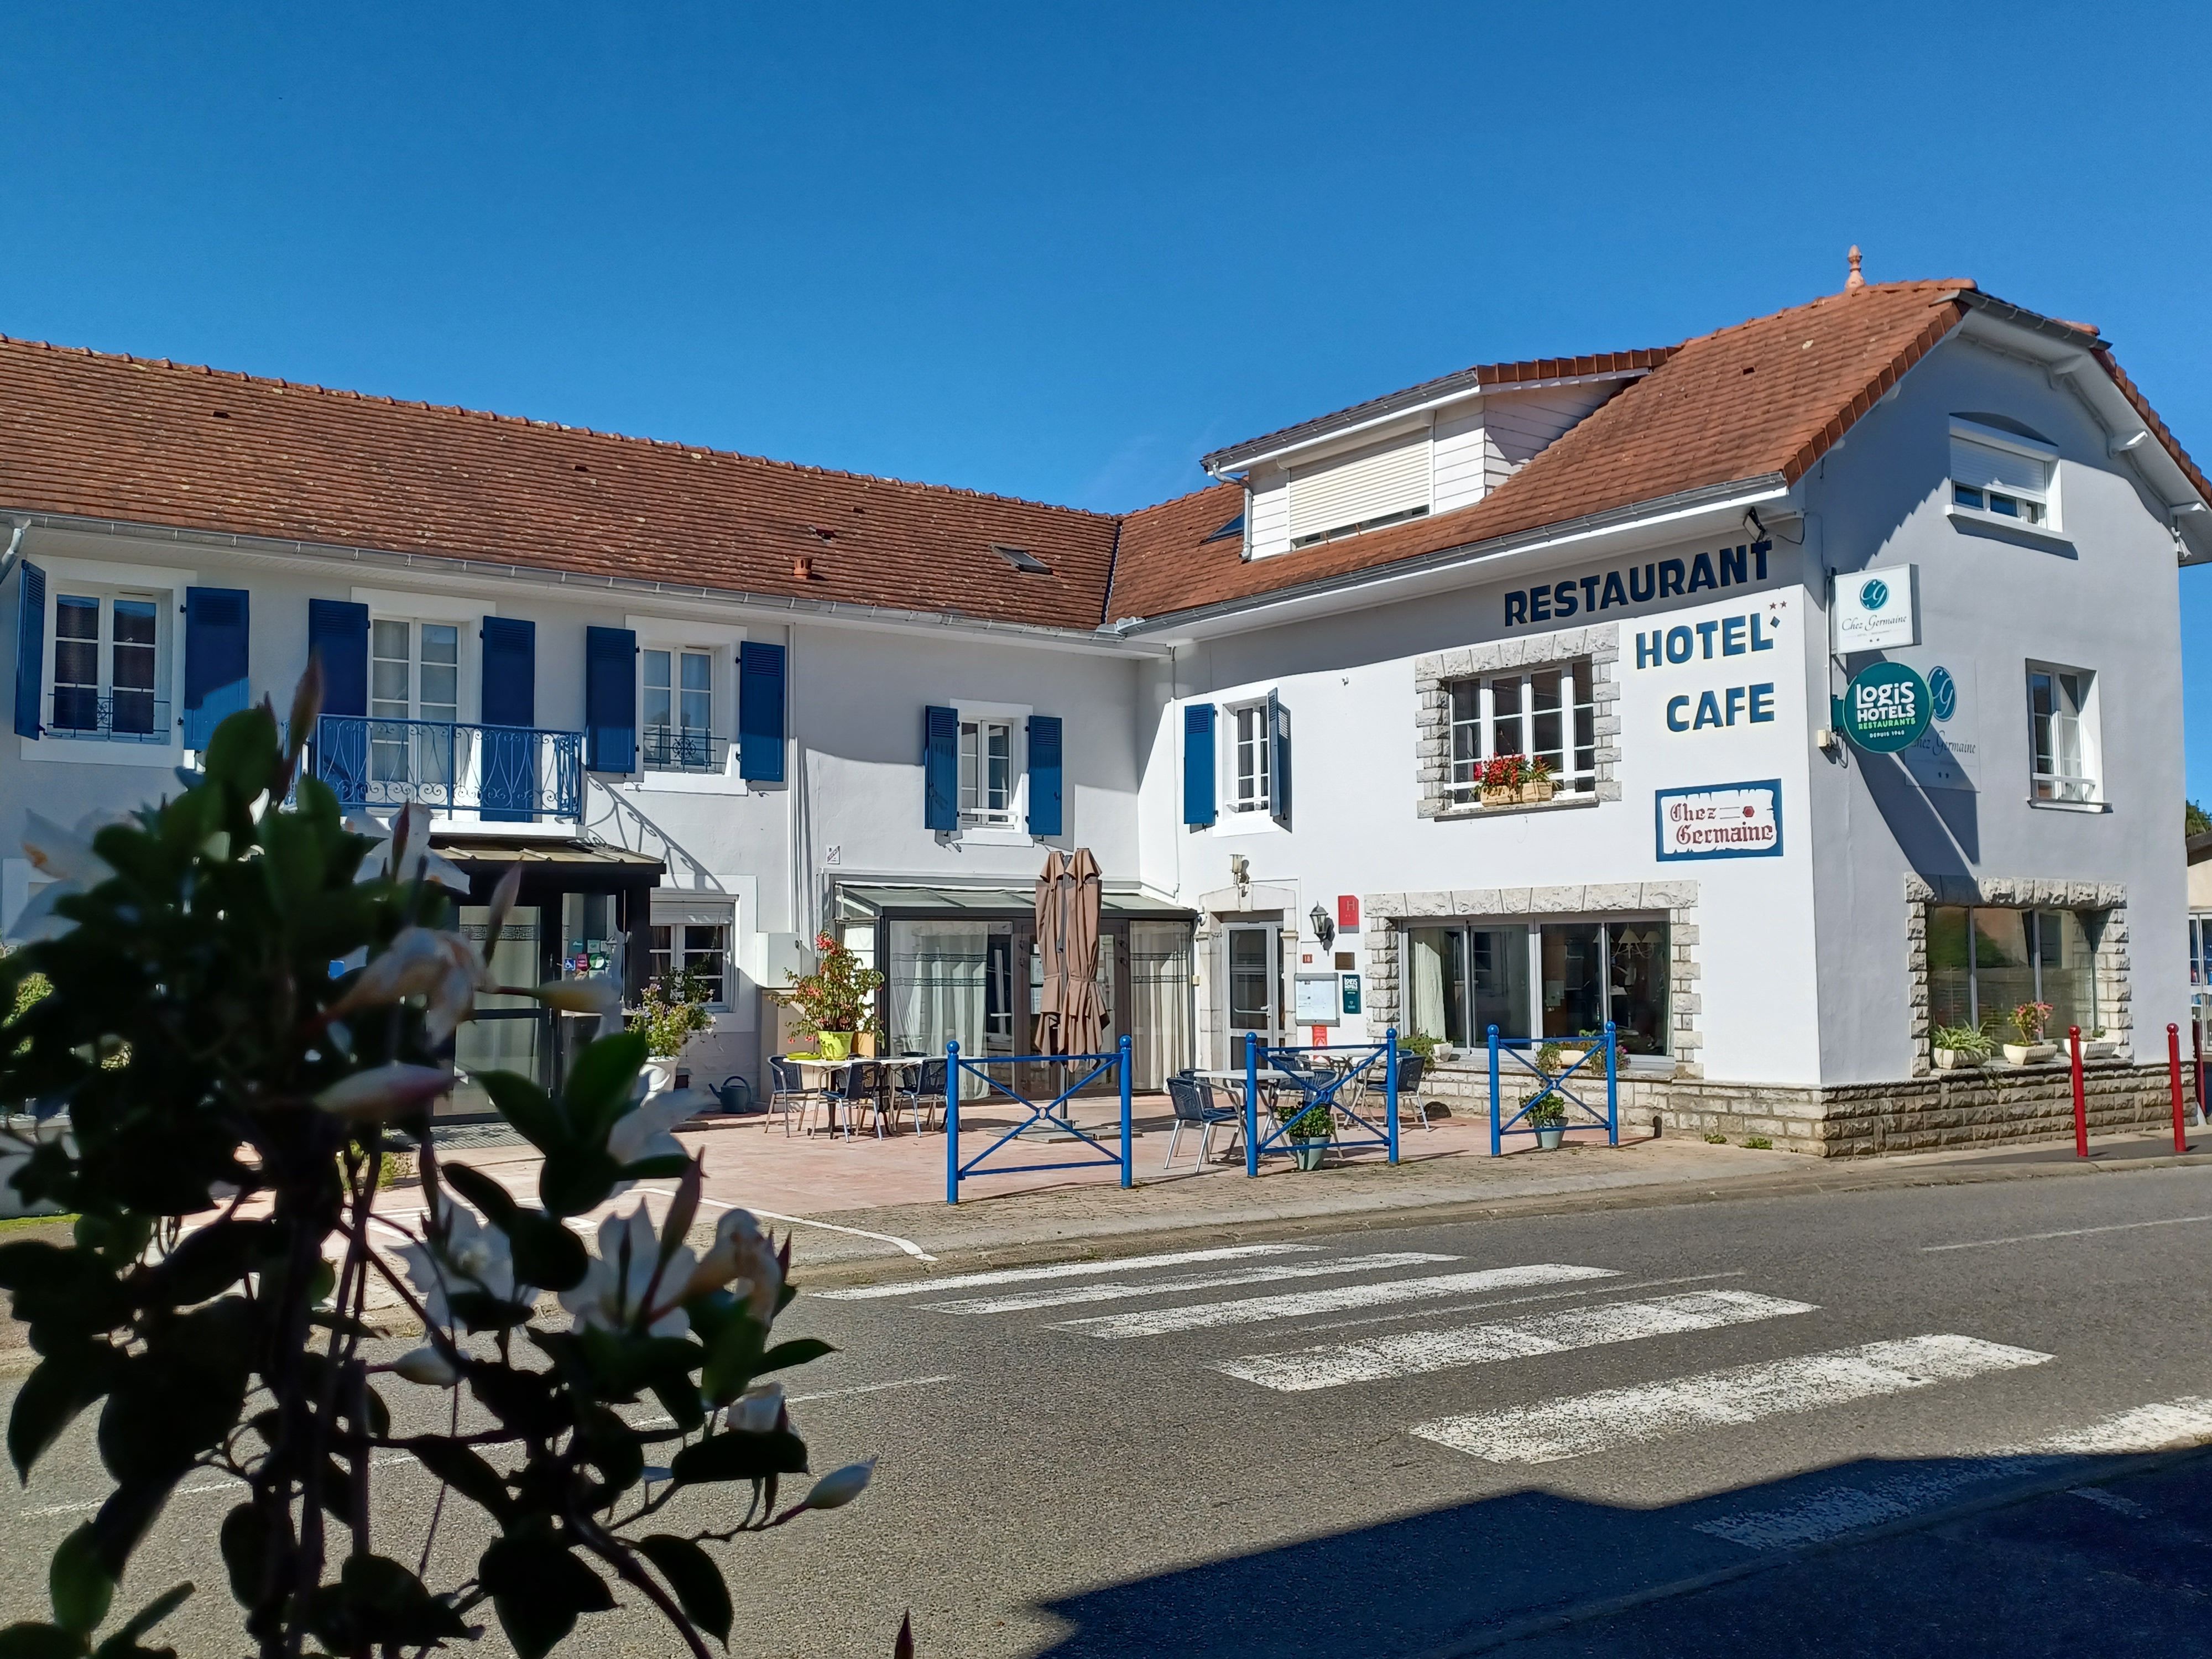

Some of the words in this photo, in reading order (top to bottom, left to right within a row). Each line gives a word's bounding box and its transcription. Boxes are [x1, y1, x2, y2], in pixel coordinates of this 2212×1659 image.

[1505, 540, 1772, 627] RESTAURANT
[1842, 617, 1863, 630] Chez
[1865, 614, 1907, 631] Germaine
[1636, 613, 1773, 670] HOTEL
[1667, 682, 1774, 732] CAFE
[1857, 703, 1916, 723] HOTELS
[1858, 717, 1916, 730] RESTAURANTS
[1932, 730, 1976, 756] Germaine
[1670, 802, 1717, 822] Chez
[1676, 821, 1773, 845] Germaine
[1347, 900, 1355, 911] H
